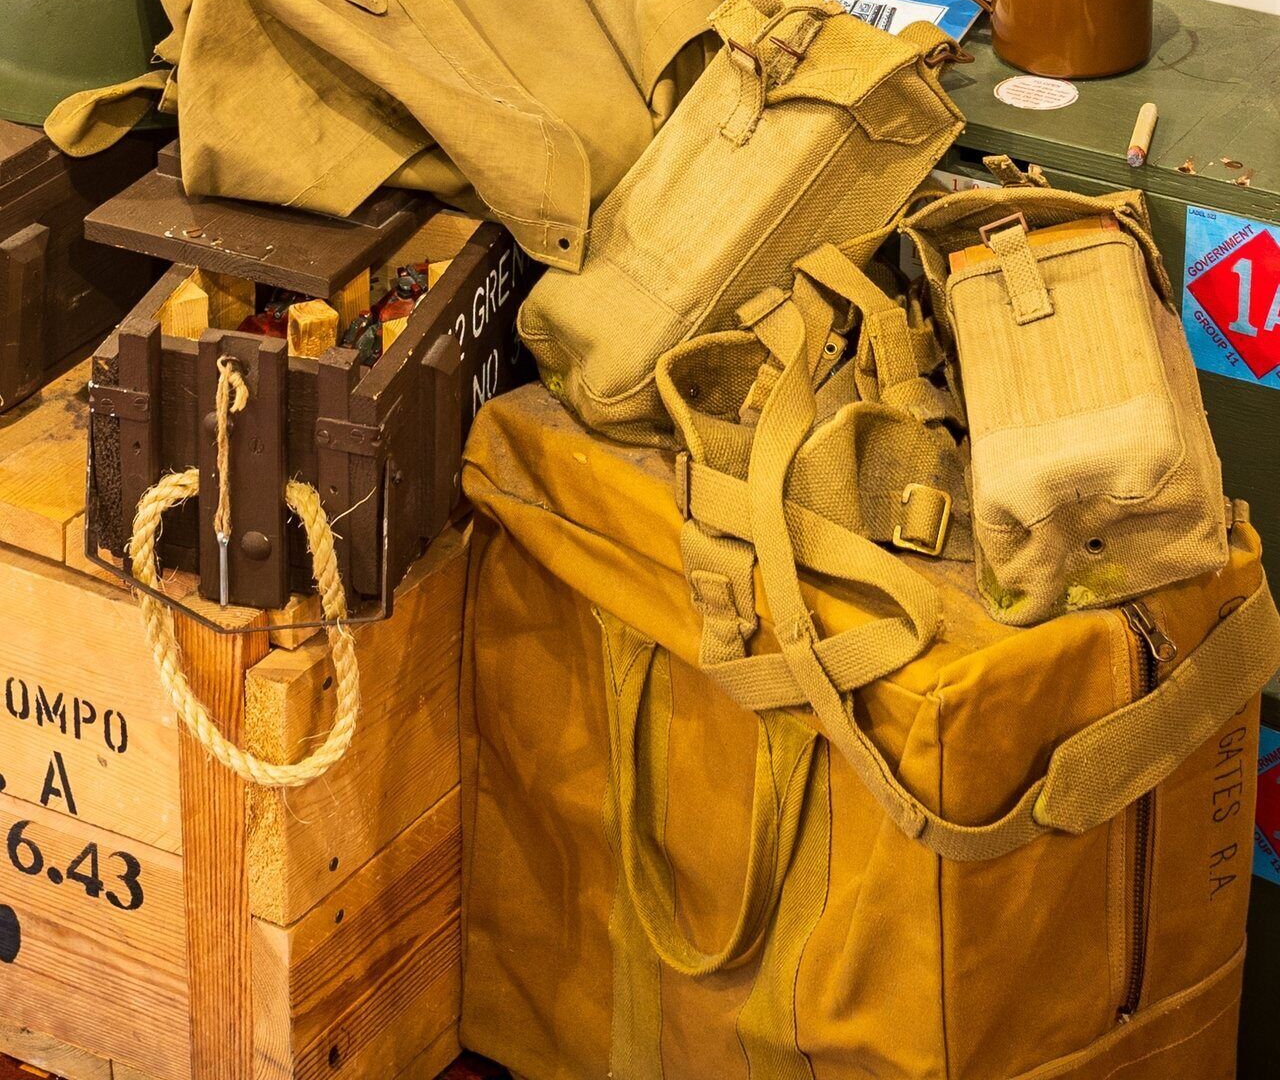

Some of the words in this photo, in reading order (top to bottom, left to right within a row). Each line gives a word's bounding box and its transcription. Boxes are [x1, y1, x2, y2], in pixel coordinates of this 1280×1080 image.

[1187, 224, 1255, 277] GOVERNMENT
[1193, 310, 1228, 350] GROUP
[1225, 350, 1240, 368] 11
[39, 750, 78, 816] A
[1212, 726, 1247, 822] GATES
[6, 819, 145, 911] 6.43
